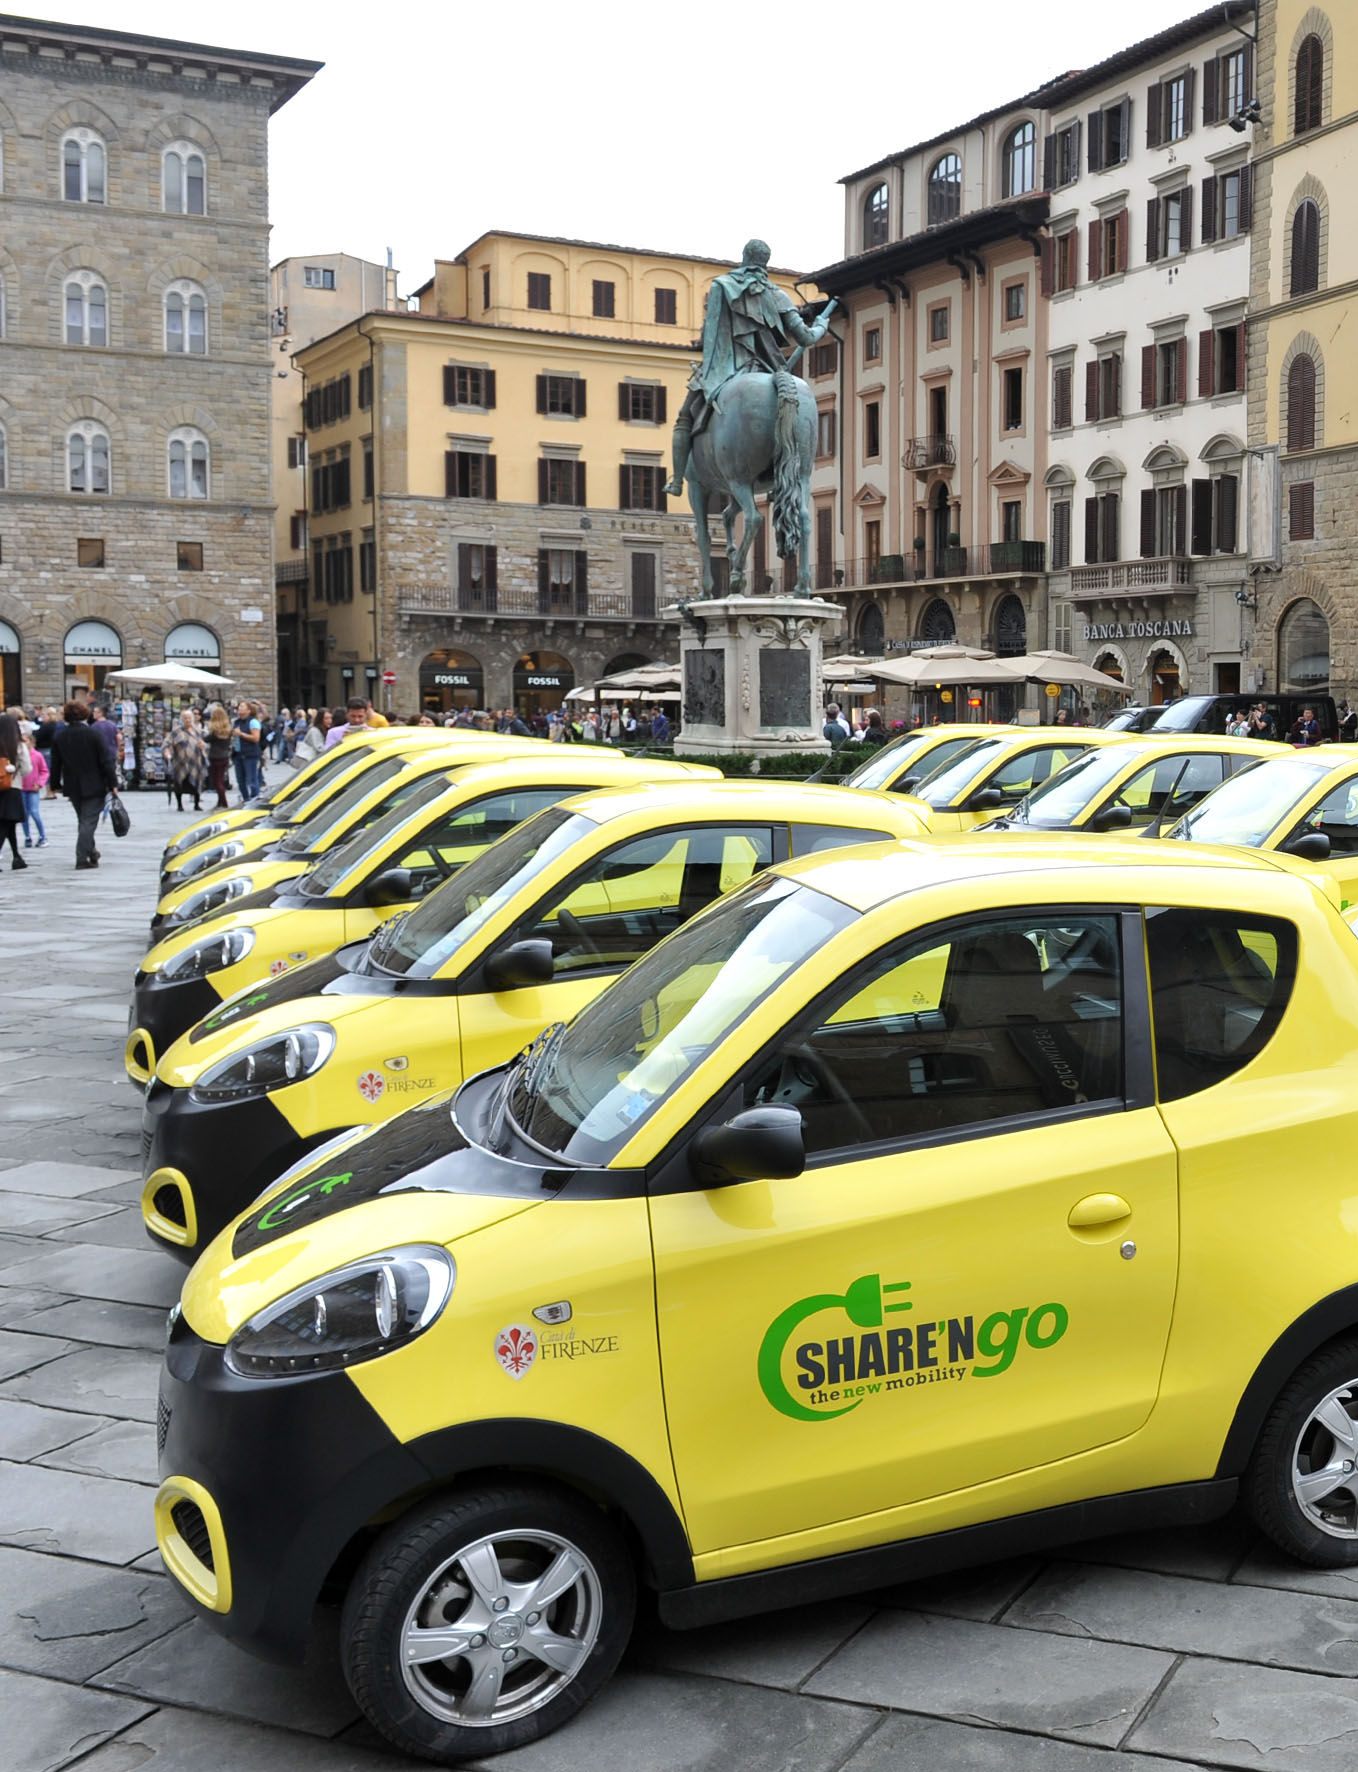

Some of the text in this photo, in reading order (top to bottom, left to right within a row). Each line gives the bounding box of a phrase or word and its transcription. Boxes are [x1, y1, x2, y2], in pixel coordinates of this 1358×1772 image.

[1083, 620, 1192, 639] BANCA TOSCANA
[72, 646, 113, 654] CHANEL
[172, 648, 211, 656] CHANEL
[435, 675, 470, 684] FOSSIL
[528, 676, 560, 686] FOSSIL
[386, 1078, 437, 1092] FIRENZE
[541, 1336, 620, 1360] FIRENZE
[810, 1366, 967, 1405] the new mobility
